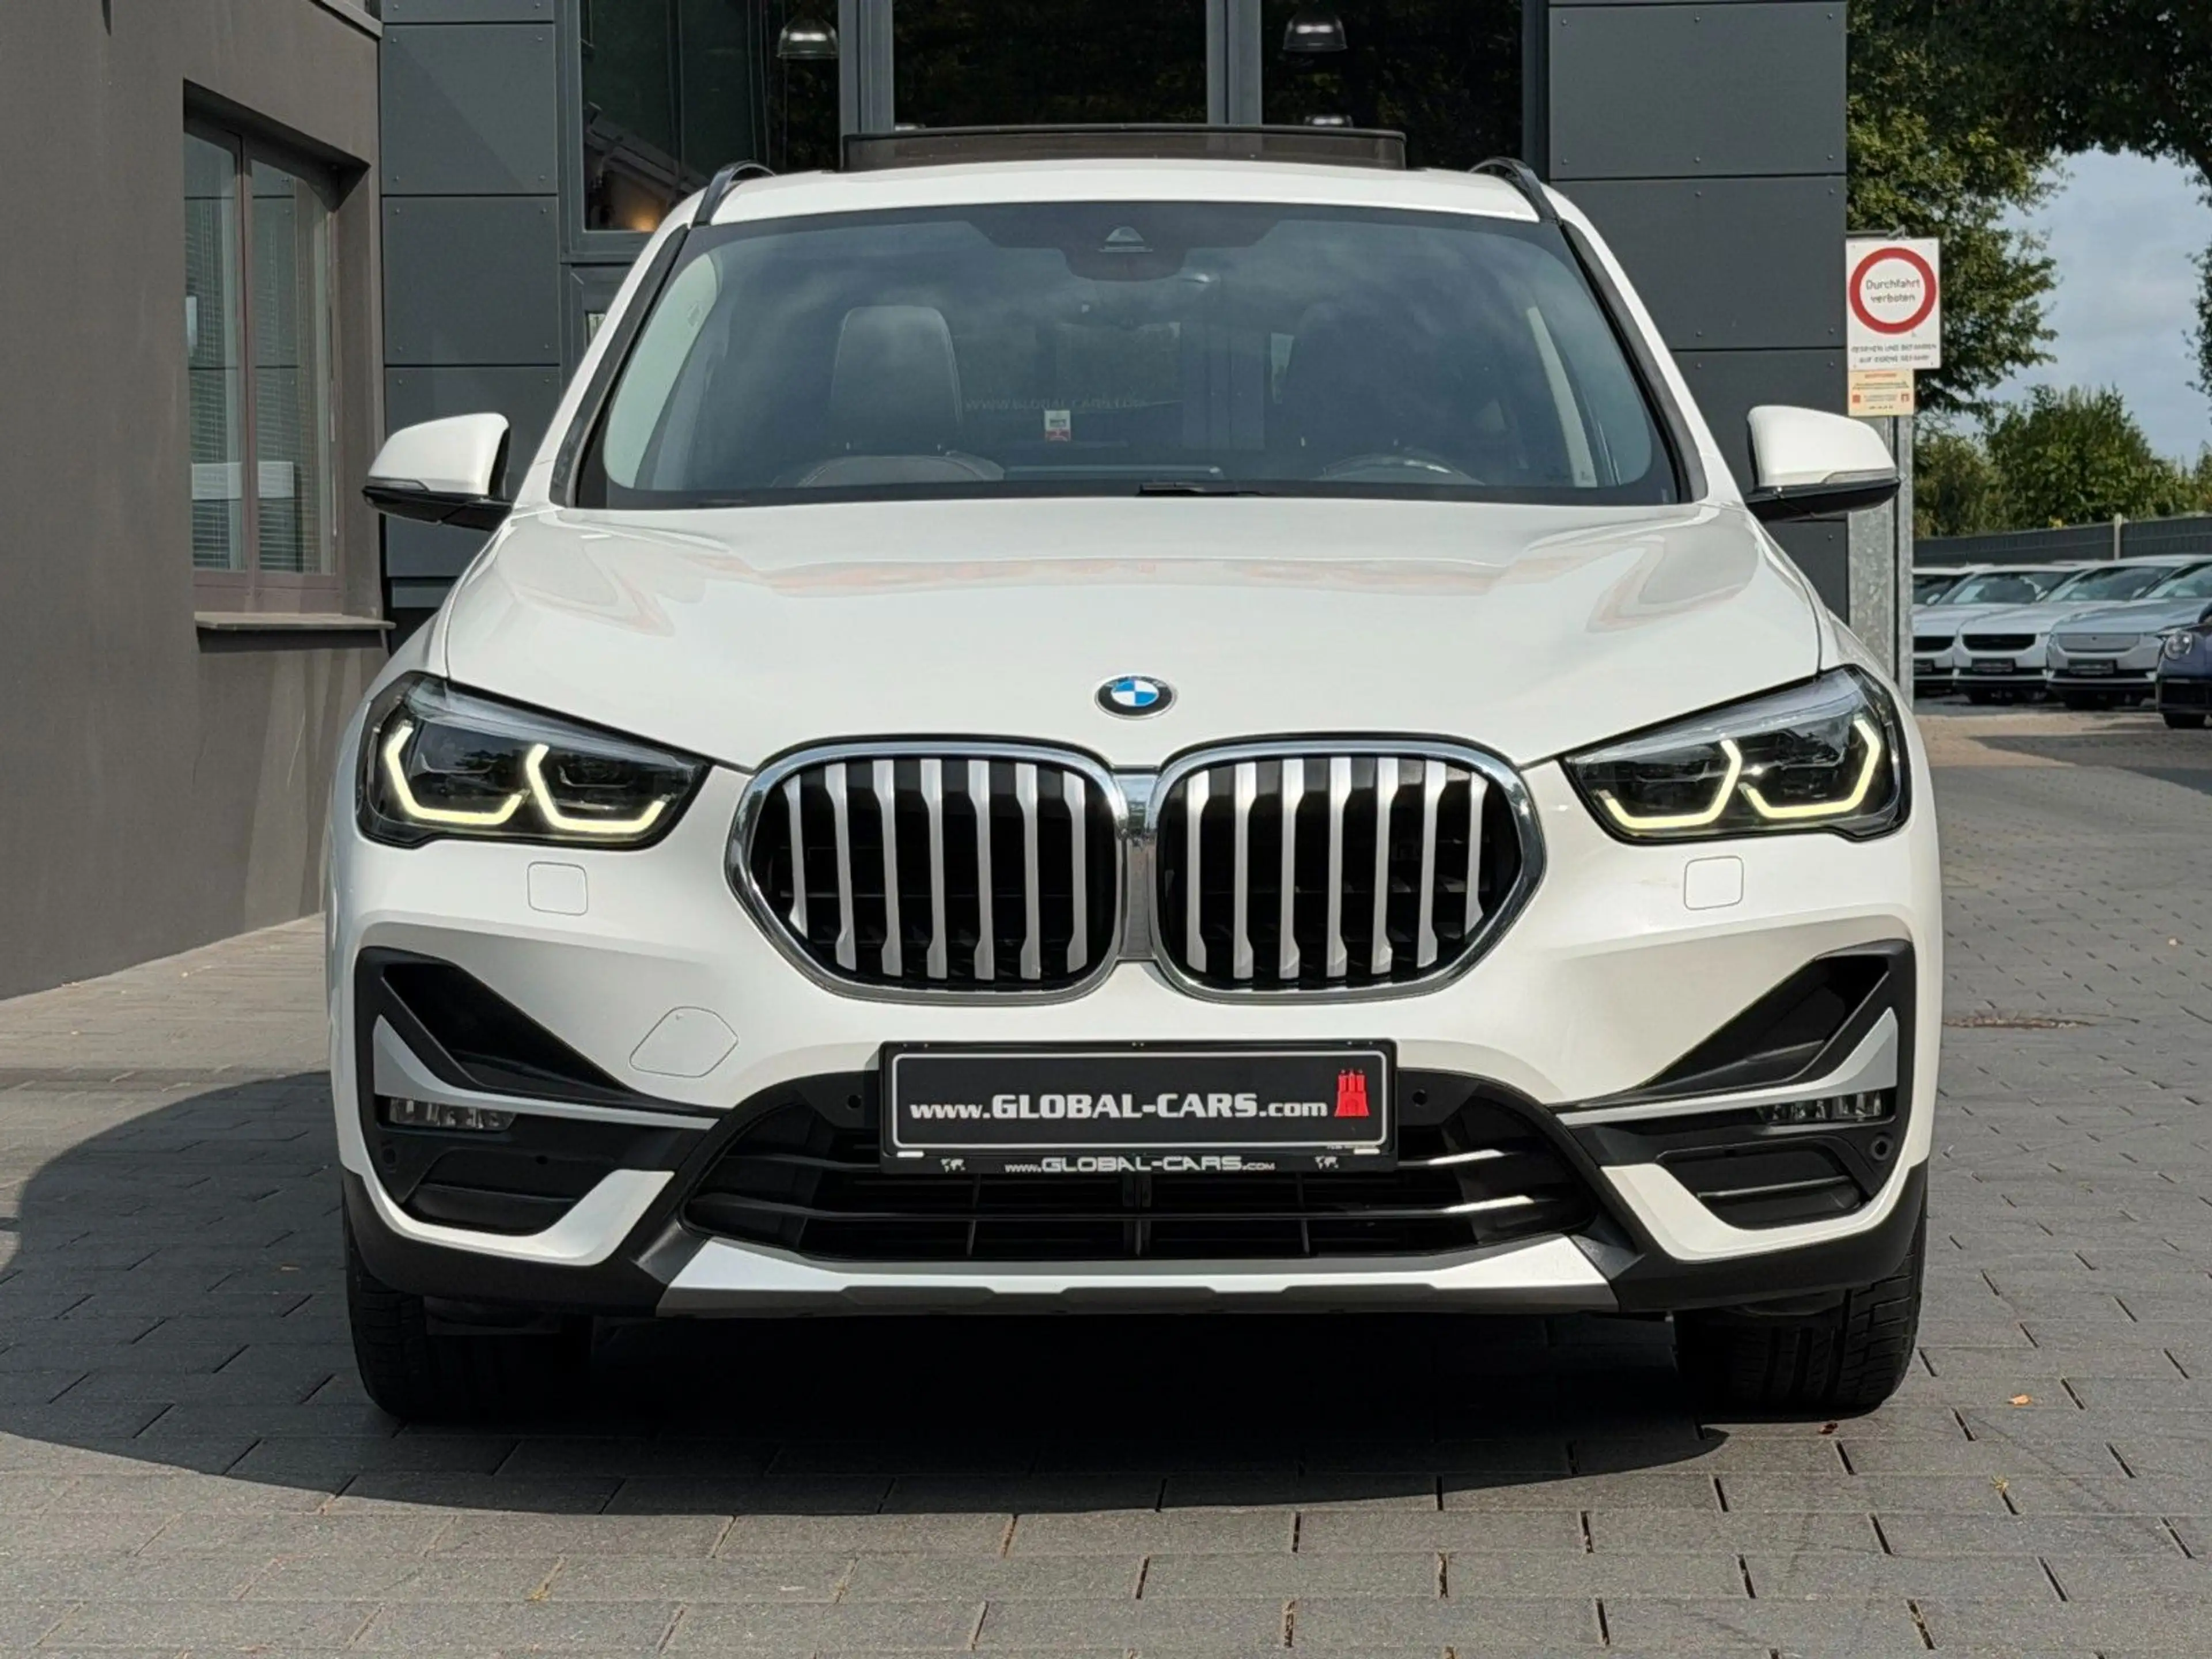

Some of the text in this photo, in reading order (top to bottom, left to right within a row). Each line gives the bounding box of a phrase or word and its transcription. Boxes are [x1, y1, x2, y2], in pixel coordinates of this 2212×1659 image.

[1866, 279, 1920, 290] Durchfahrt
[1870, 293, 1915, 303] verboten
[909, 1093, 1328, 1119] www.GLOBAL-CARS.com
